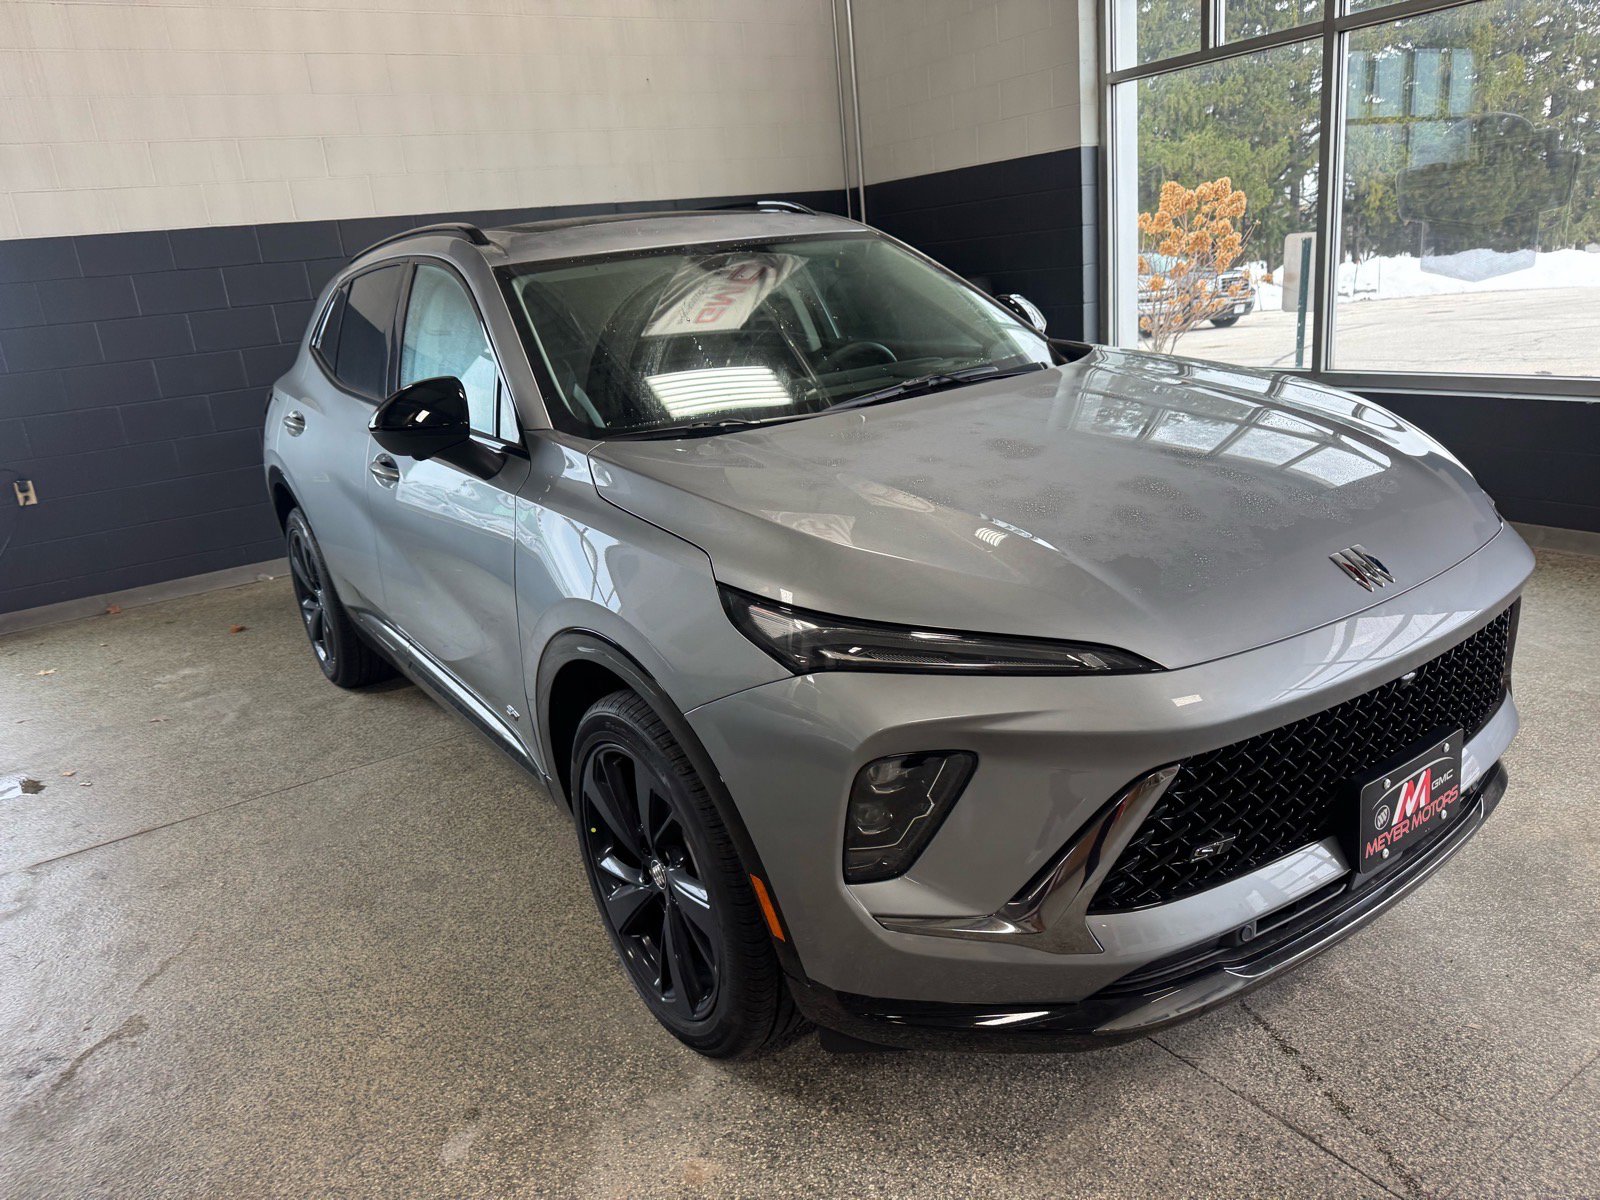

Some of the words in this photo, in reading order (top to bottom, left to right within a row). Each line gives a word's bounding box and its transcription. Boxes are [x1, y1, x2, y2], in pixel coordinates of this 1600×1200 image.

[1391, 768, 1431, 826] M
[1431, 768, 1454, 791] GMC
[1365, 818, 1410, 859] MEYER
[1411, 784, 1459, 831] MOTORS
